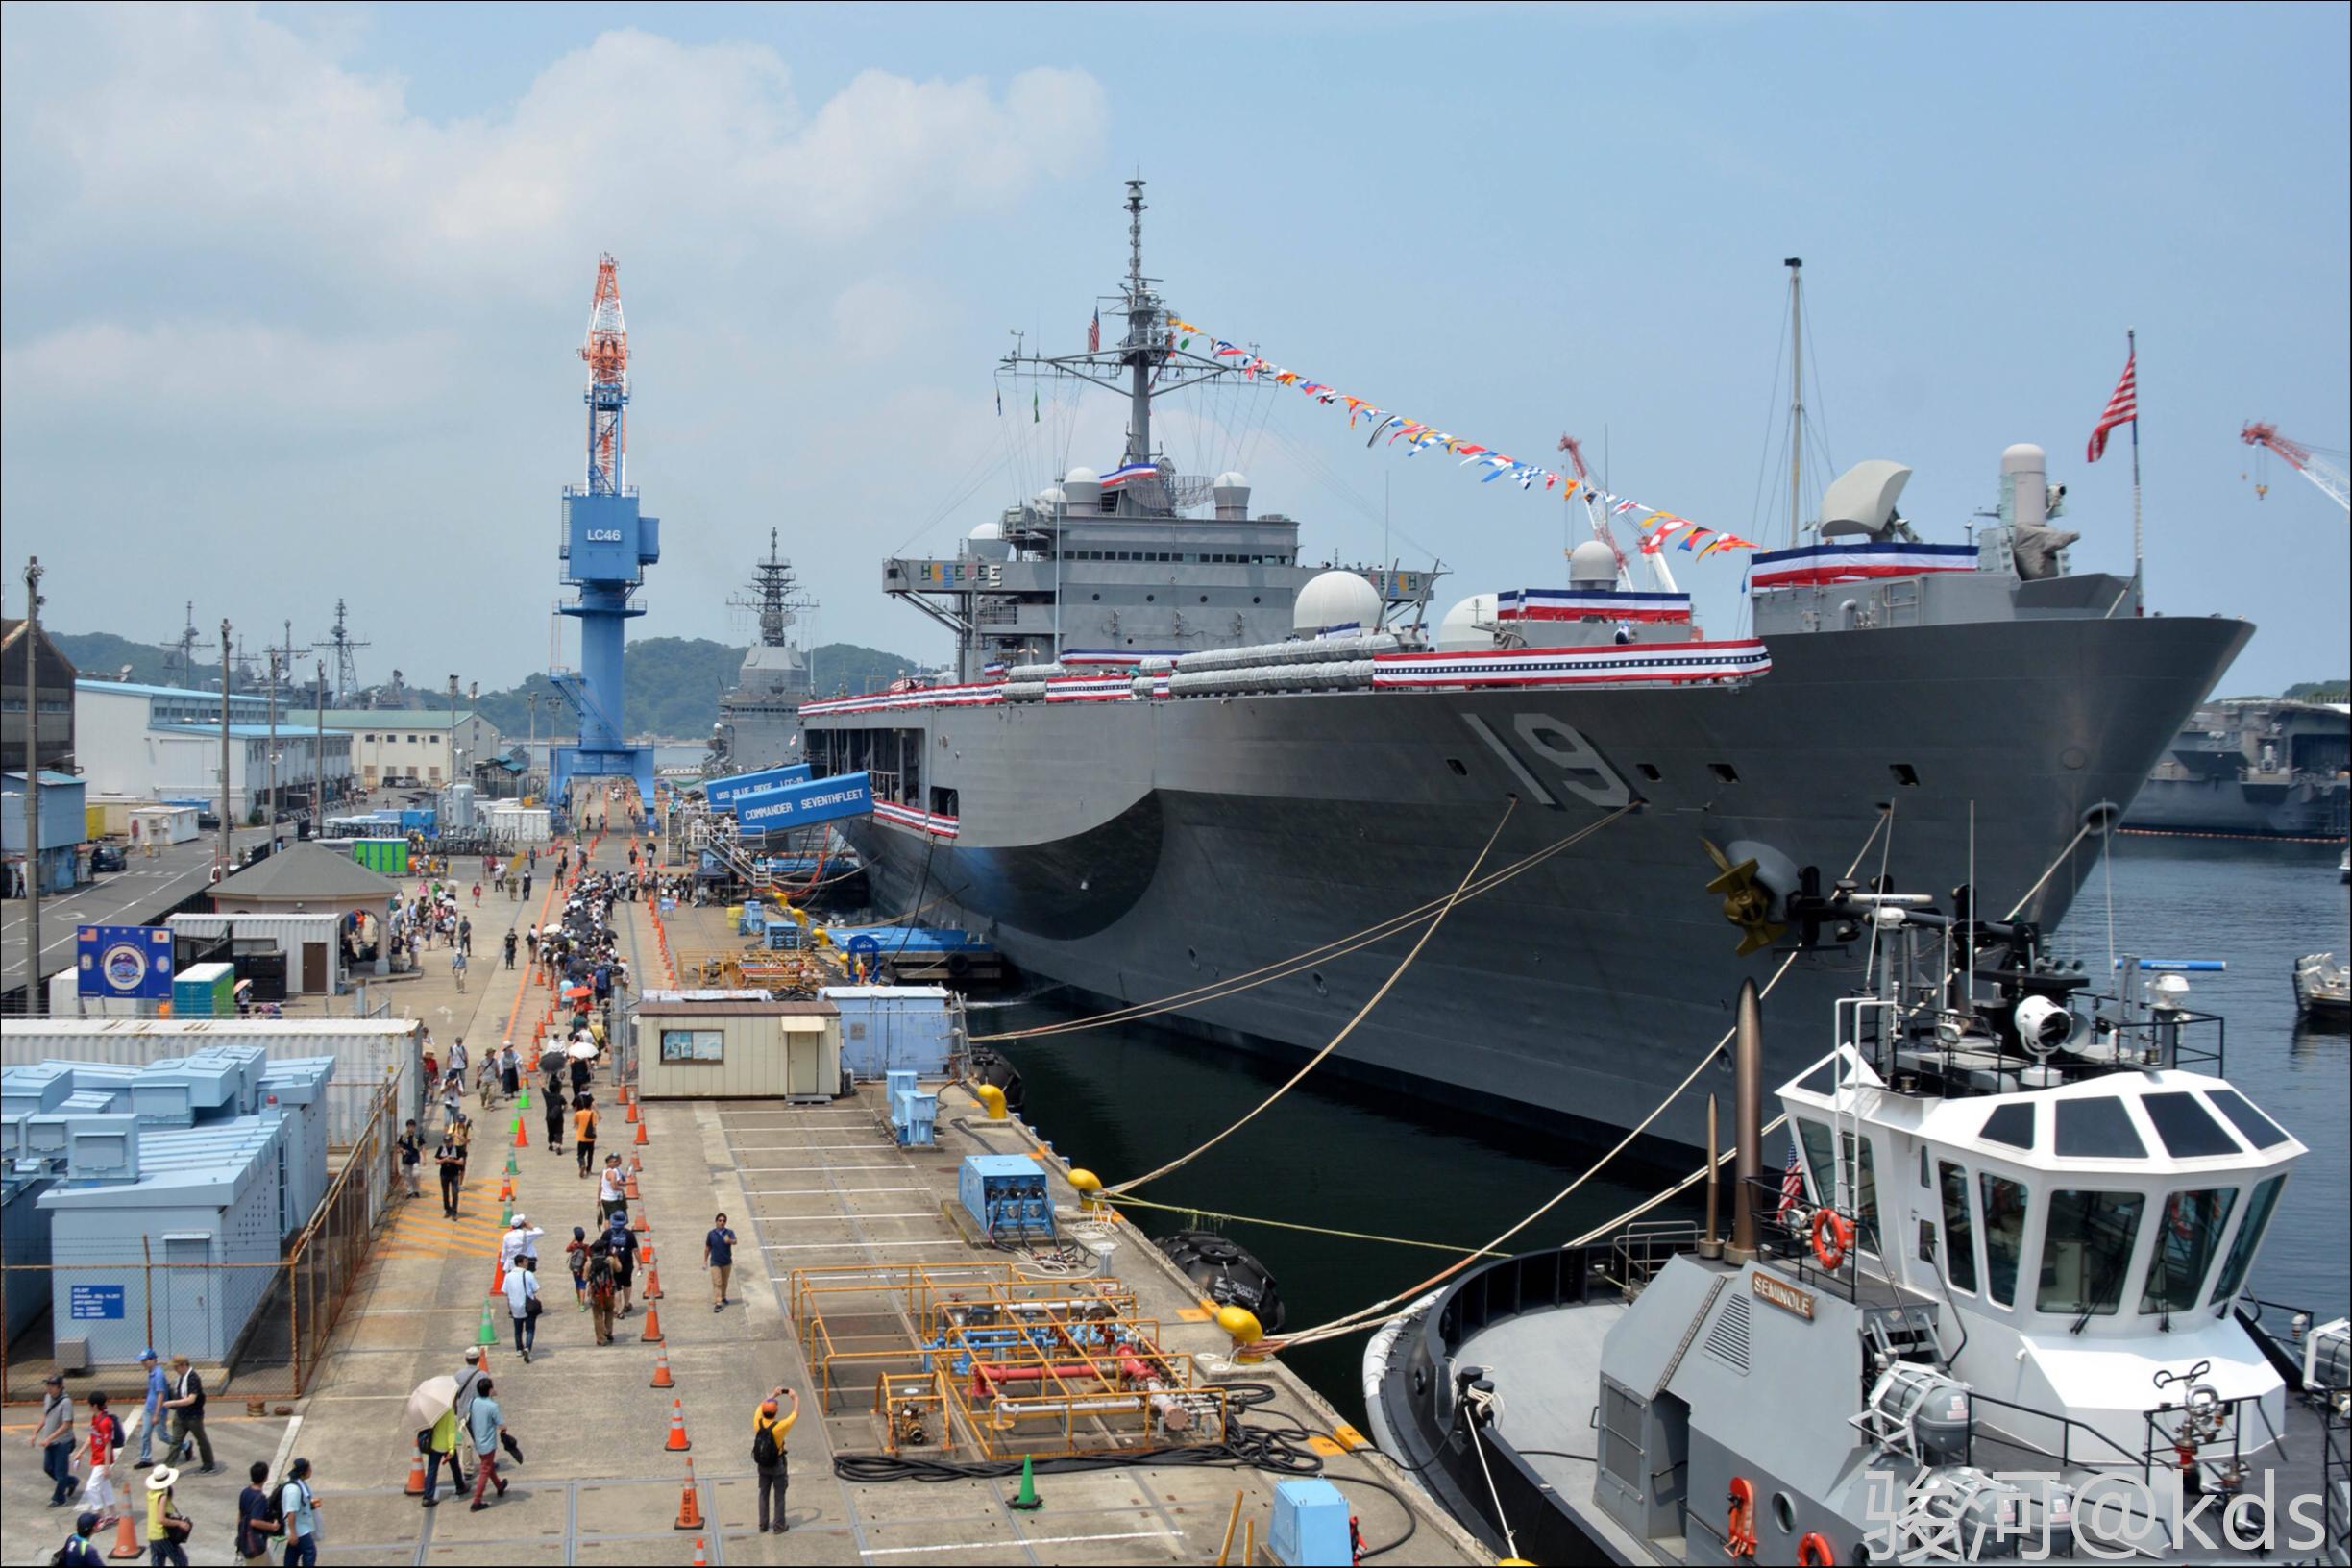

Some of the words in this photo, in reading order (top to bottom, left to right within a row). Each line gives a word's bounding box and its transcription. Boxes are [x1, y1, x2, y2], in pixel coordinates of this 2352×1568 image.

[587, 529, 621, 541] LC46
[1461, 713, 1630, 807] 19
[716, 791, 730, 800] USS
[732, 786, 749, 797] BLUE
[753, 782, 772, 793] RIDGE
[745, 802, 793, 821] COMMANDER
[800, 789, 863, 810] SEVENTHFLEET
[1753, 1276, 1810, 1315] SEMINOLE
